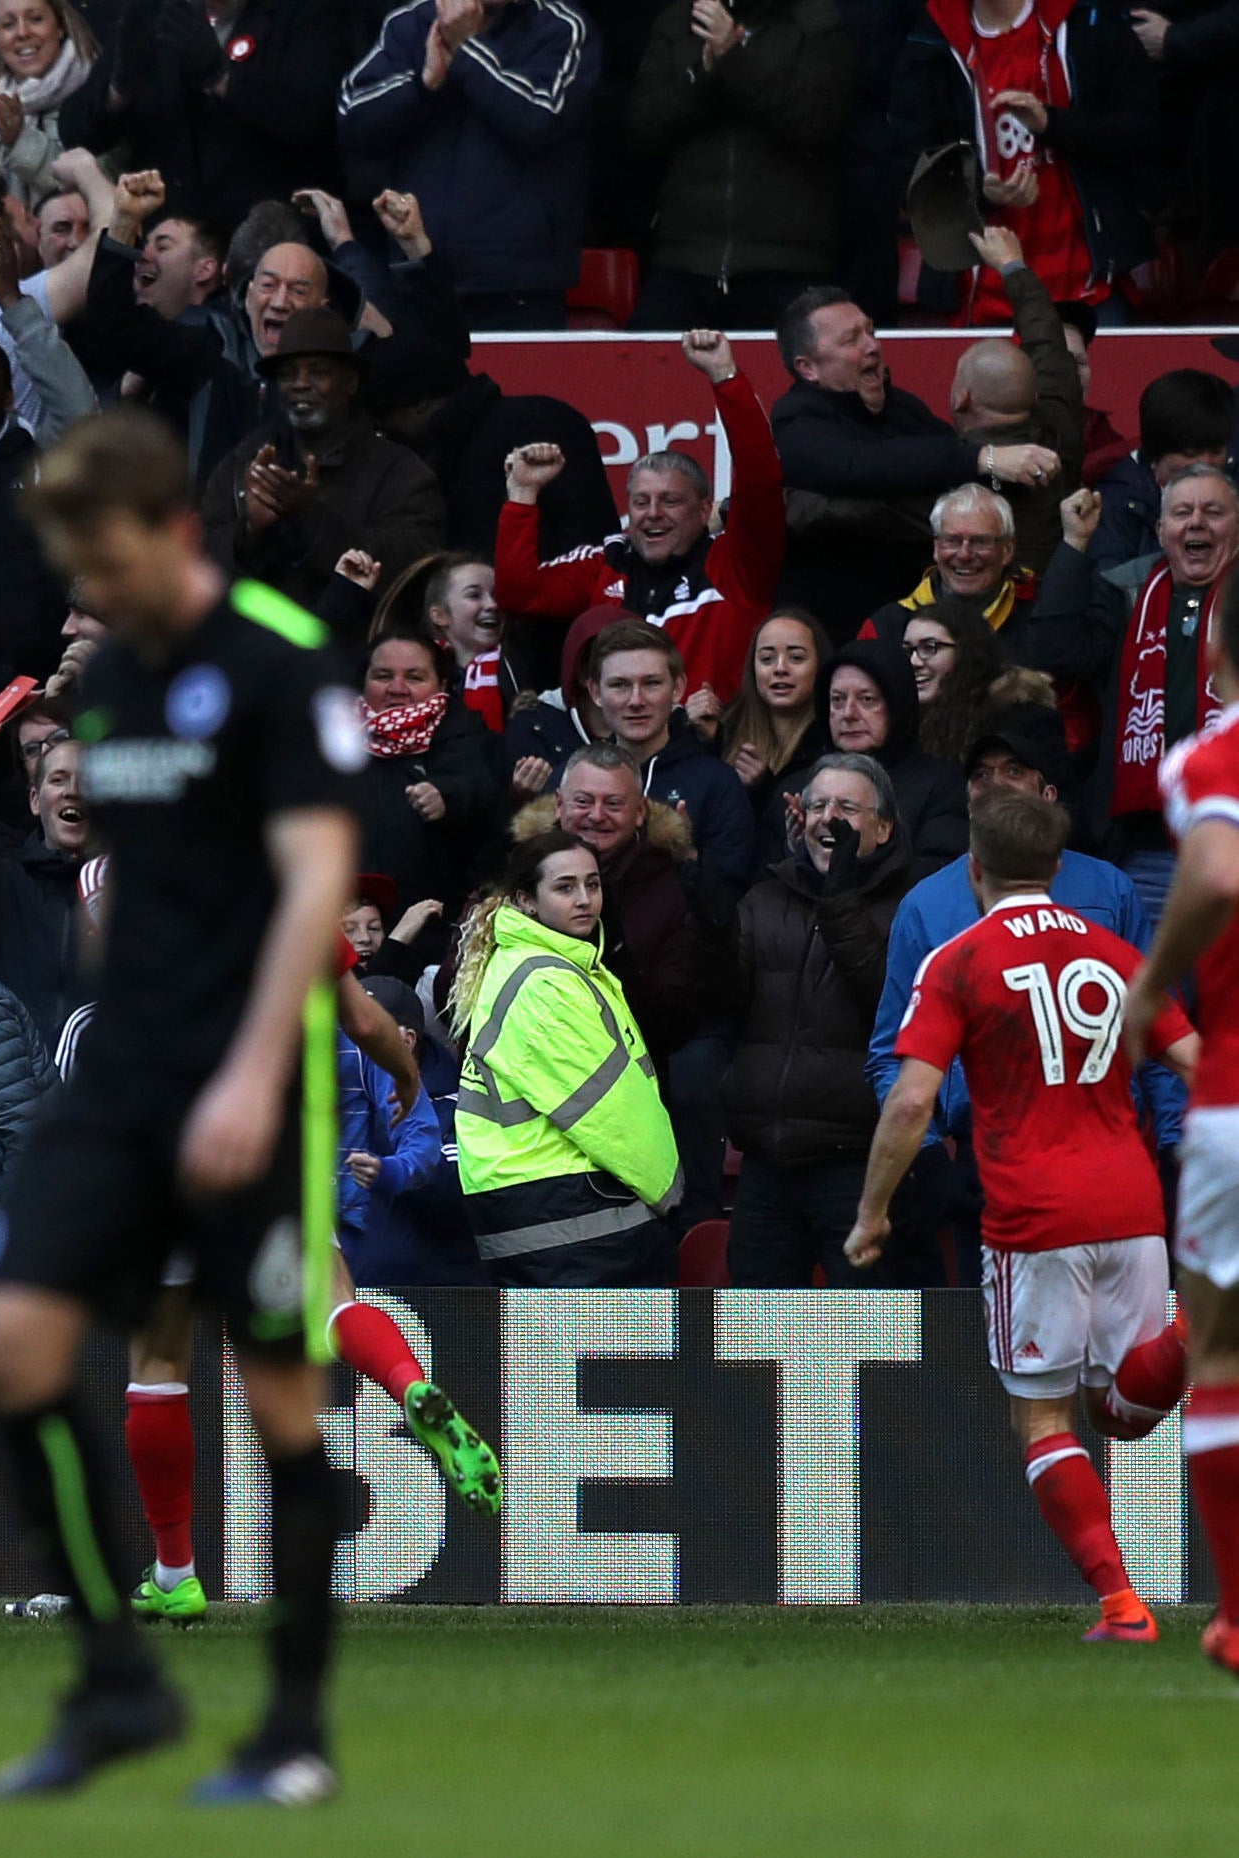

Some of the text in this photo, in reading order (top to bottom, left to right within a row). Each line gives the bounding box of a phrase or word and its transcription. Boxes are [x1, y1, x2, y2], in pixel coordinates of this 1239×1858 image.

[1003, 909, 1089, 939] WARD
[1001, 957, 1128, 1086] 19
[222, 1287, 924, 1607] BET
